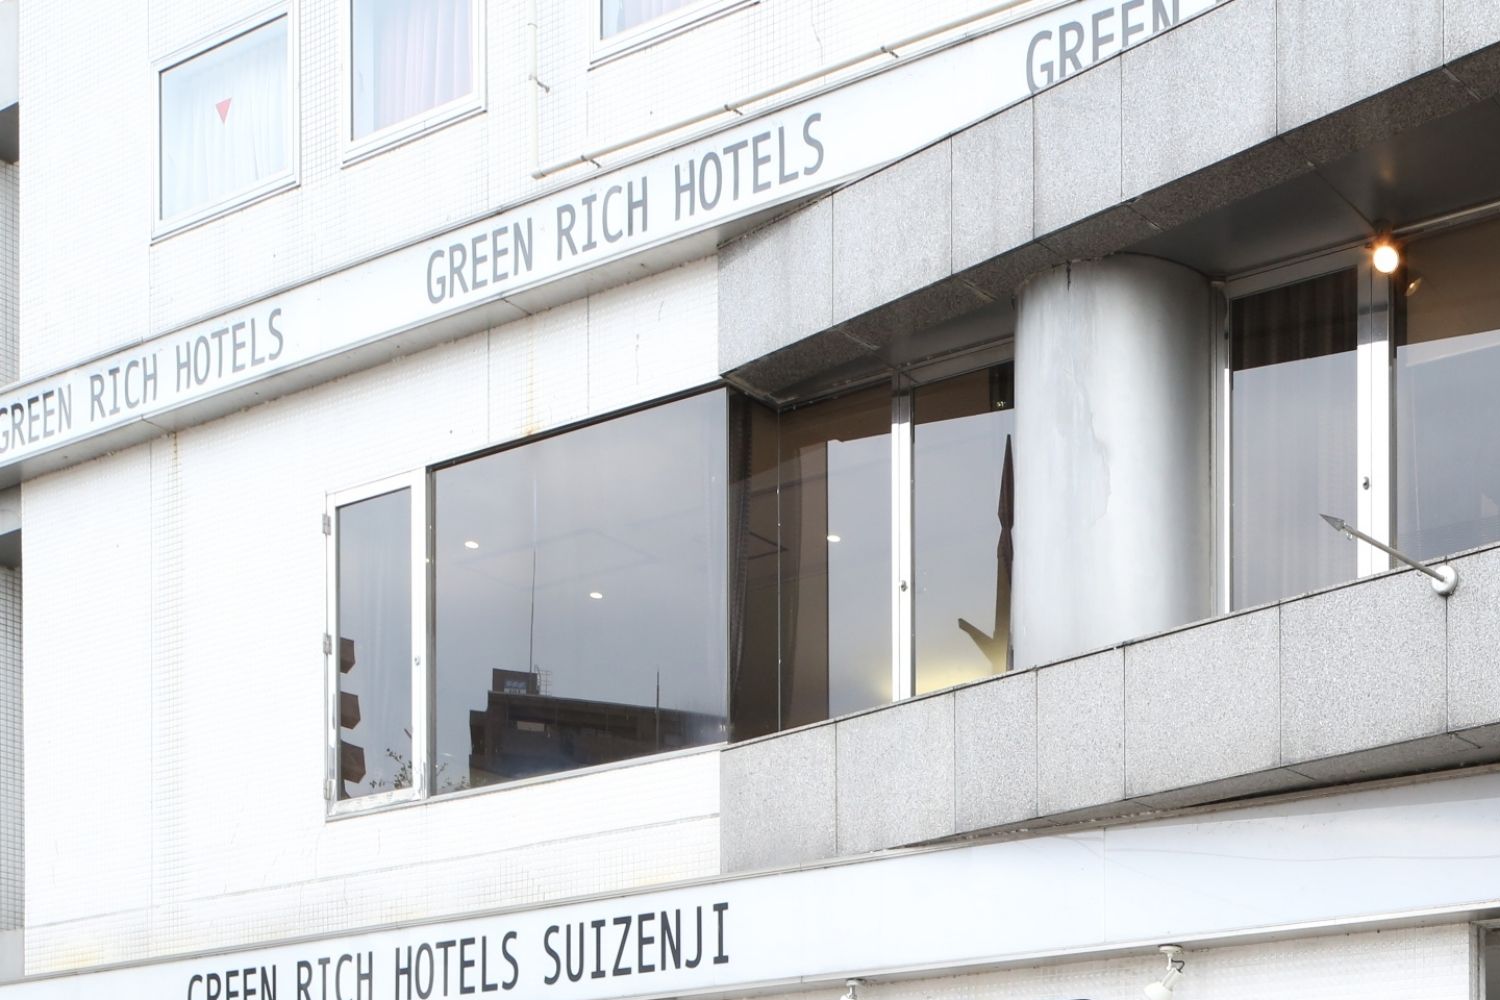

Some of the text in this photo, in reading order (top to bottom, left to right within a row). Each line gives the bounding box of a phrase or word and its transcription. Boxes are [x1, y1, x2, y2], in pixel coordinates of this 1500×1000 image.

[426, 113, 824, 304] GREEN RICH HOTELS
[0, 308, 284, 455] GREEN RICH HOTELS
[543, 902, 729, 986] SUIZENJI
